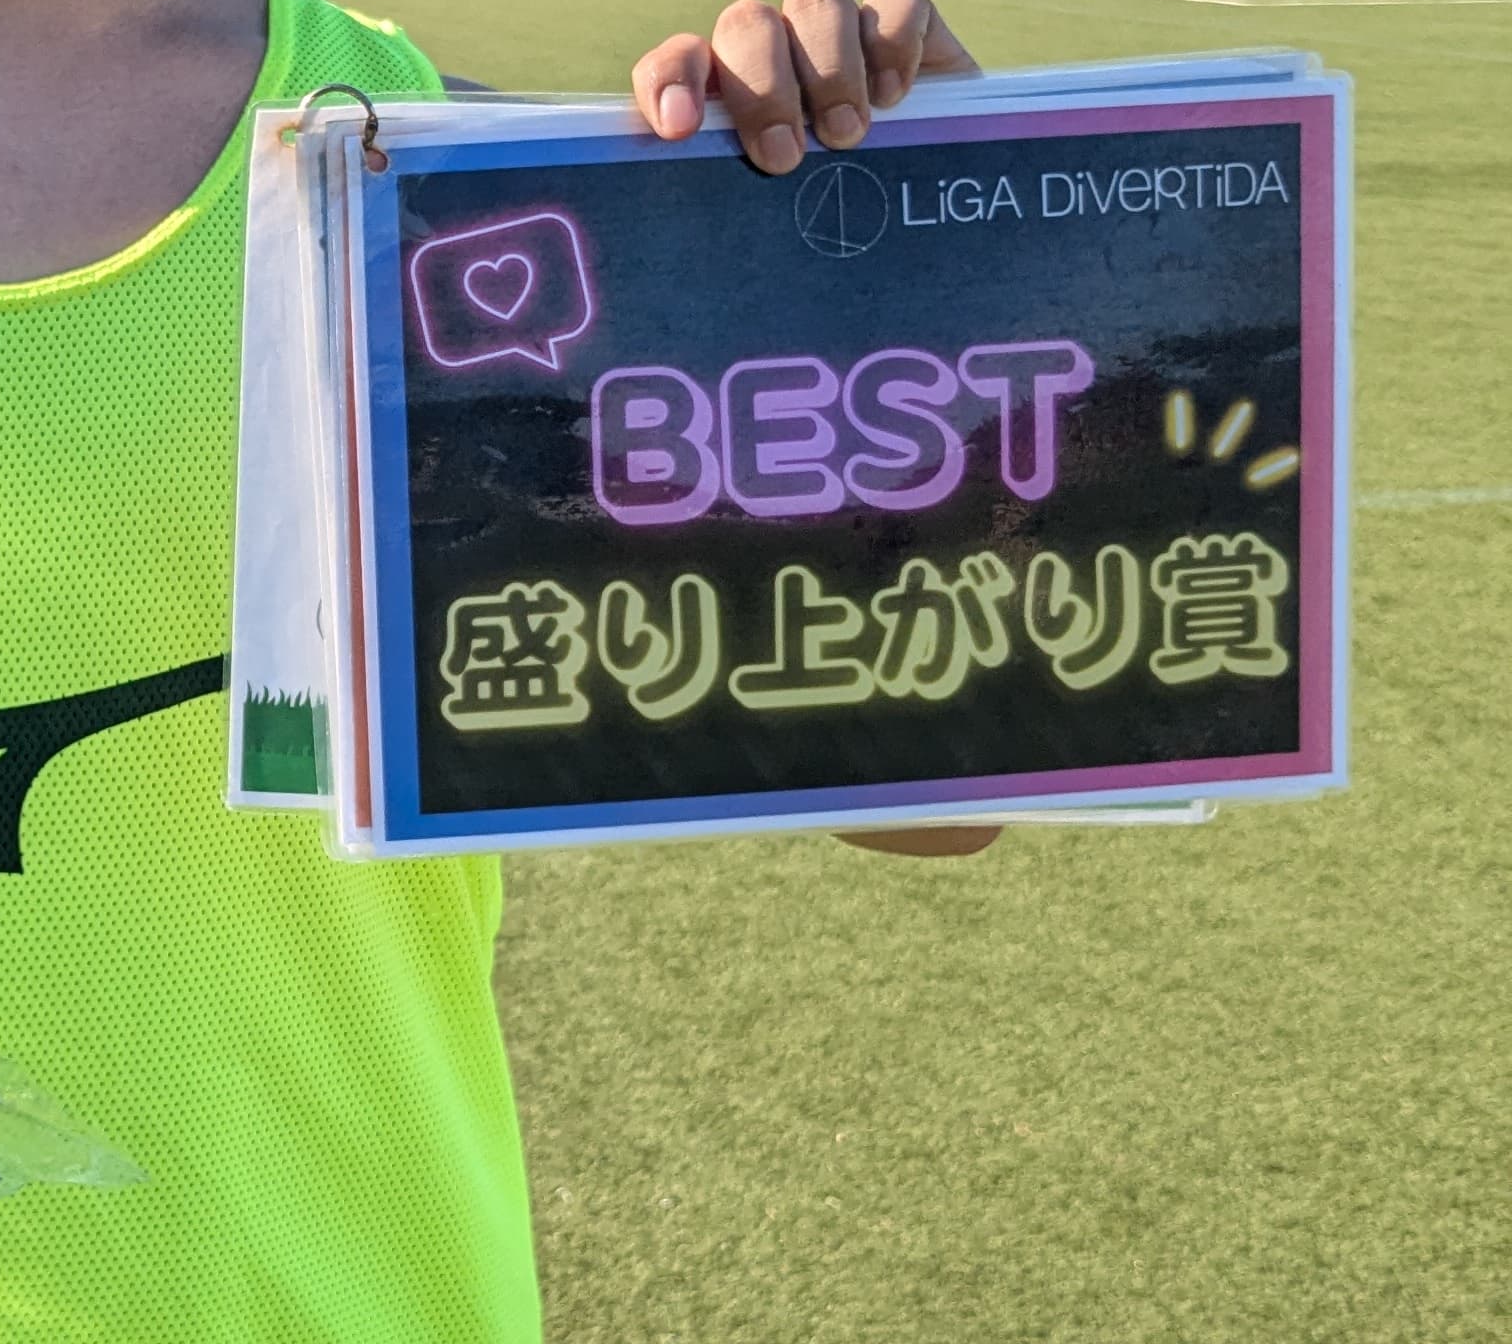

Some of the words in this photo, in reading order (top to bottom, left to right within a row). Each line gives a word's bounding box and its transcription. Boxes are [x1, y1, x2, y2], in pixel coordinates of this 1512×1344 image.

[591, 339, 1095, 527] BEST
[439, 532, 1290, 732] 盛り上がり賞
